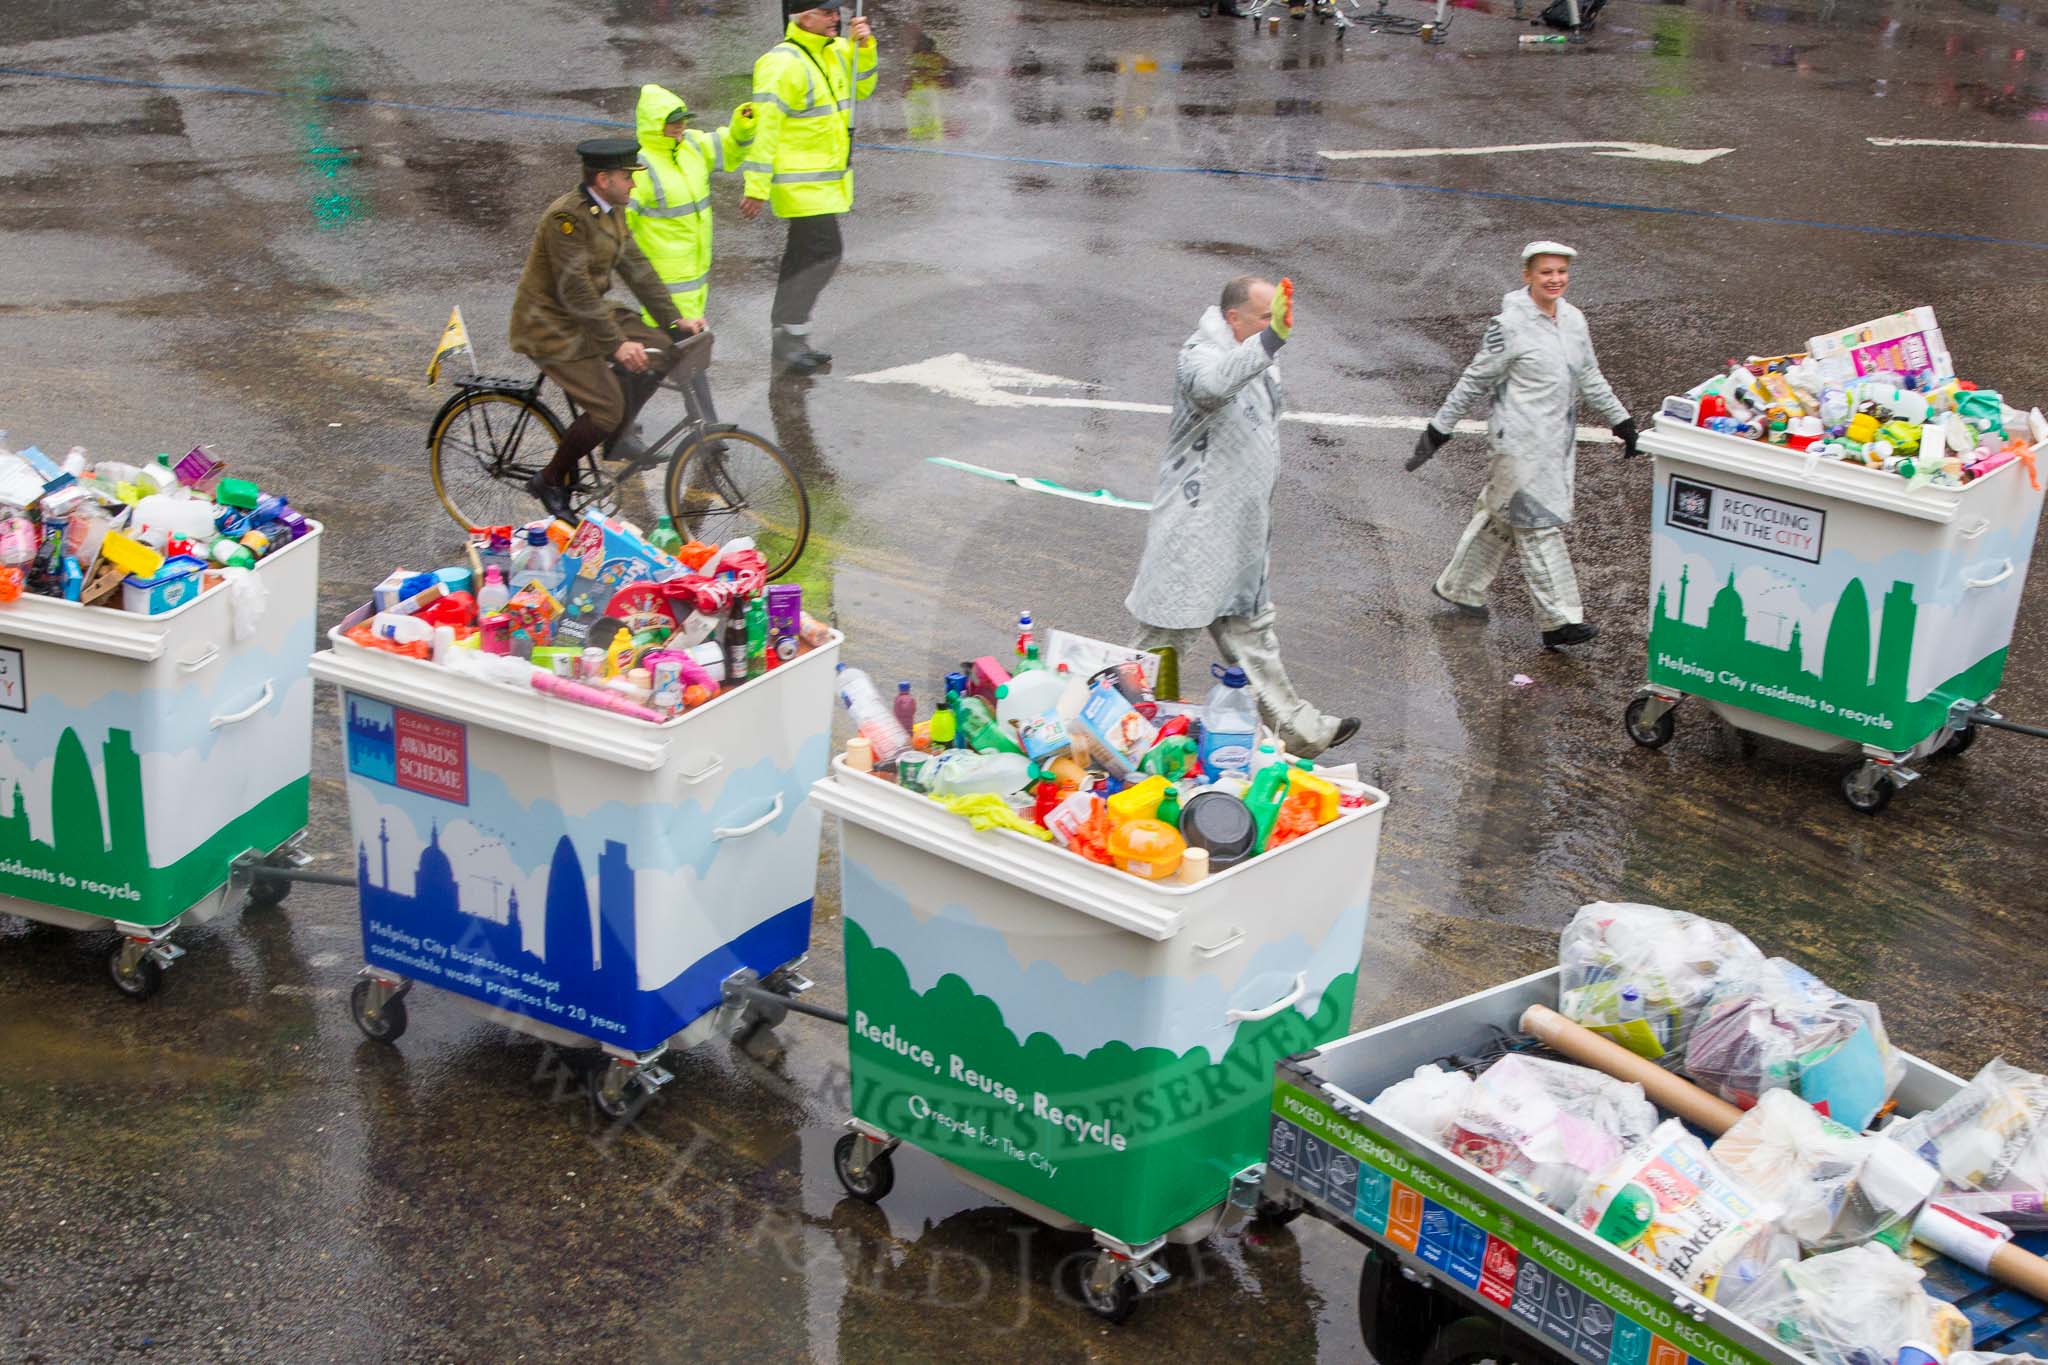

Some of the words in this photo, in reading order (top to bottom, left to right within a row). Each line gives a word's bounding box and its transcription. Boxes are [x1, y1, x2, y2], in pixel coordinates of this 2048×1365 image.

[1720, 516, 1739, 533] IN
[1743, 521, 1772, 540] THE
[1775, 529, 1813, 549] CITY
[1722, 498, 1809, 531] RECYCLING
[1657, 652, 1715, 683] Helping
[1718, 670, 1747, 691] City
[1750, 680, 1817, 709] residents
[1819, 699, 1835, 714] to
[1839, 706, 1895, 730] recycle
[400, 736, 459, 766] AWARDS
[400, 758, 462, 789] SCHEME
[0, 858, 55, 883] sidents
[59, 872, 77, 888] to
[81, 881, 141, 901] recycle
[370, 920, 421, 950] Helping
[422, 938, 448, 960] City
[451, 945, 519, 979] businesses
[521, 972, 560, 993] adopt
[371, 944, 442, 975] sustainable
[444, 967, 483, 988] waste
[486, 980, 543, 1008] practices
[545, 996, 565, 1015] for
[568, 1005, 586, 1021] 20
[590, 1013, 627, 1034] years
[855, 1010, 941, 1075] Reduce,
[950, 1053, 1024, 1112] Reuse,
[1033, 1091, 1127, 1152] Recycle
[931, 1109, 977, 1139] recycle
[980, 1126, 998, 1148] for
[1003, 1136, 1026, 1161] The
[1028, 1152, 1058, 1179] City
[1283, 1095, 1325, 1127] MIXED
[1325, 1118, 1409, 1173] HOUSEHOLD
[1410, 1166, 1488, 1218] RECYCLING
[1531, 1236, 1577, 1272] MIXED
[1578, 1264, 1672, 1328] HOUSEHOLD
[1673, 1320, 1752, 1365] RECYCLIN
